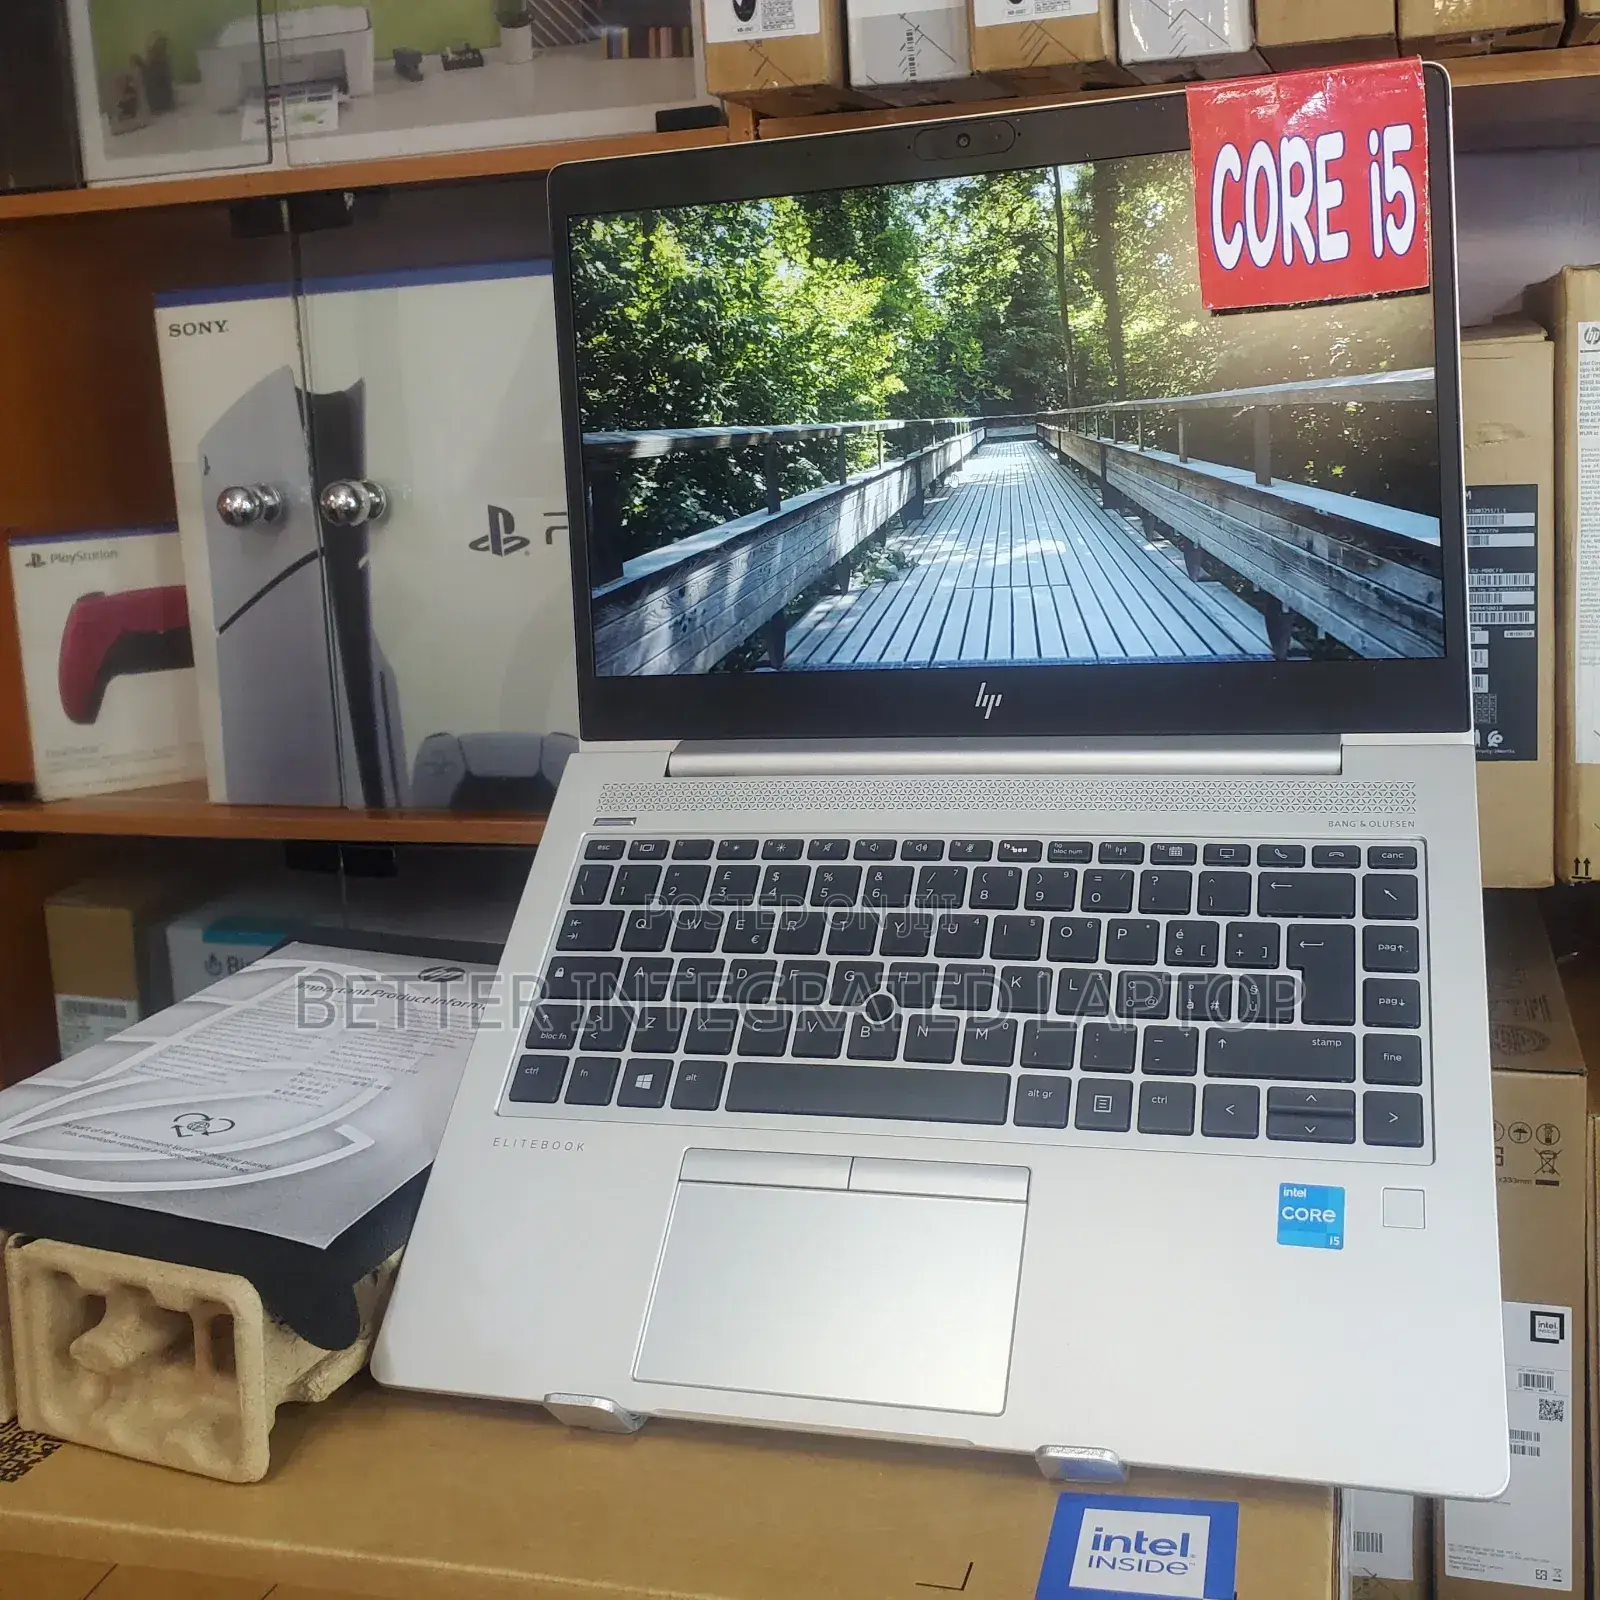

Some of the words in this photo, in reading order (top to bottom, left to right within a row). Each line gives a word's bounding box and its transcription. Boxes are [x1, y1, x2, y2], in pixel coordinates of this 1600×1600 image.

[1211, 130, 1350, 270] CORE
[1368, 123, 1417, 258] i5
[168, 319, 228, 338] SONY
[1328, 820, 1356, 828] BANG
[1360, 820, 1366, 828] &
[1368, 820, 1415, 828] OLUFSEN
[1381, 851, 1404, 859] canc
[772, 871, 781, 882] $
[823, 872, 833, 882] %
[874, 871, 883, 882] &
[668, 886, 677, 896] 2
[718, 886, 727, 896] 3
[768, 887, 777, 897] 4
[819, 888, 829, 898] 5
[871, 888, 881, 898] 6
[925, 888, 934, 899] 7
[979, 889, 988, 900] 8
[1035, 890, 1045, 901] 9
[635, 918, 647, 930] Q
[687, 918, 701, 929] W
[735, 919, 745, 930] E
[786, 920, 797, 931] R
[839, 920, 848, 931] T
[894, 921, 904, 933] Y
[948, 923, 958, 934] U
[1116, 927, 1128, 940] P
[1378, 944, 1396, 952] pag
[633, 967, 645, 978] A
[685, 967, 695, 979] S
[736, 968, 748, 979] D
[788, 969, 799, 980] F
[844, 970, 855, 981] G
[897, 971, 908, 983] H
[953, 973, 962, 985] J
[1011, 975, 1022, 988] K
[1068, 978, 1078, 990] L
[296, 983, 370, 996] Important
[371, 989, 432, 1004] Product
[1378, 997, 1398, 1006] pag
[645, 1017, 656, 1029] Z
[698, 1018, 709, 1030] X
[752, 1019, 763, 1032] C
[807, 1021, 818, 1032] V
[540, 1031, 557, 1040] bloc
[558, 1031, 567, 1040] fn
[860, 1026, 871, 1038] B
[917, 1026, 929, 1037] N
[975, 1028, 988, 1040] M
[1311, 1037, 1342, 1048] stamp
[1383, 1052, 1402, 1062] fine
[525, 1066, 539, 1075] ctrl
[580, 1068, 588, 1077] fn
[685, 1073, 697, 1082] alt
[1028, 1089, 1040, 1097] alt
[1042, 1090, 1053, 1100] gr
[1151, 1095, 1168, 1104] ctrl
[493, 1137, 585, 1151] ELITEBOOK
[1283, 1187, 1307, 1198] intel
[1329, 1235, 1340, 1246] i5
